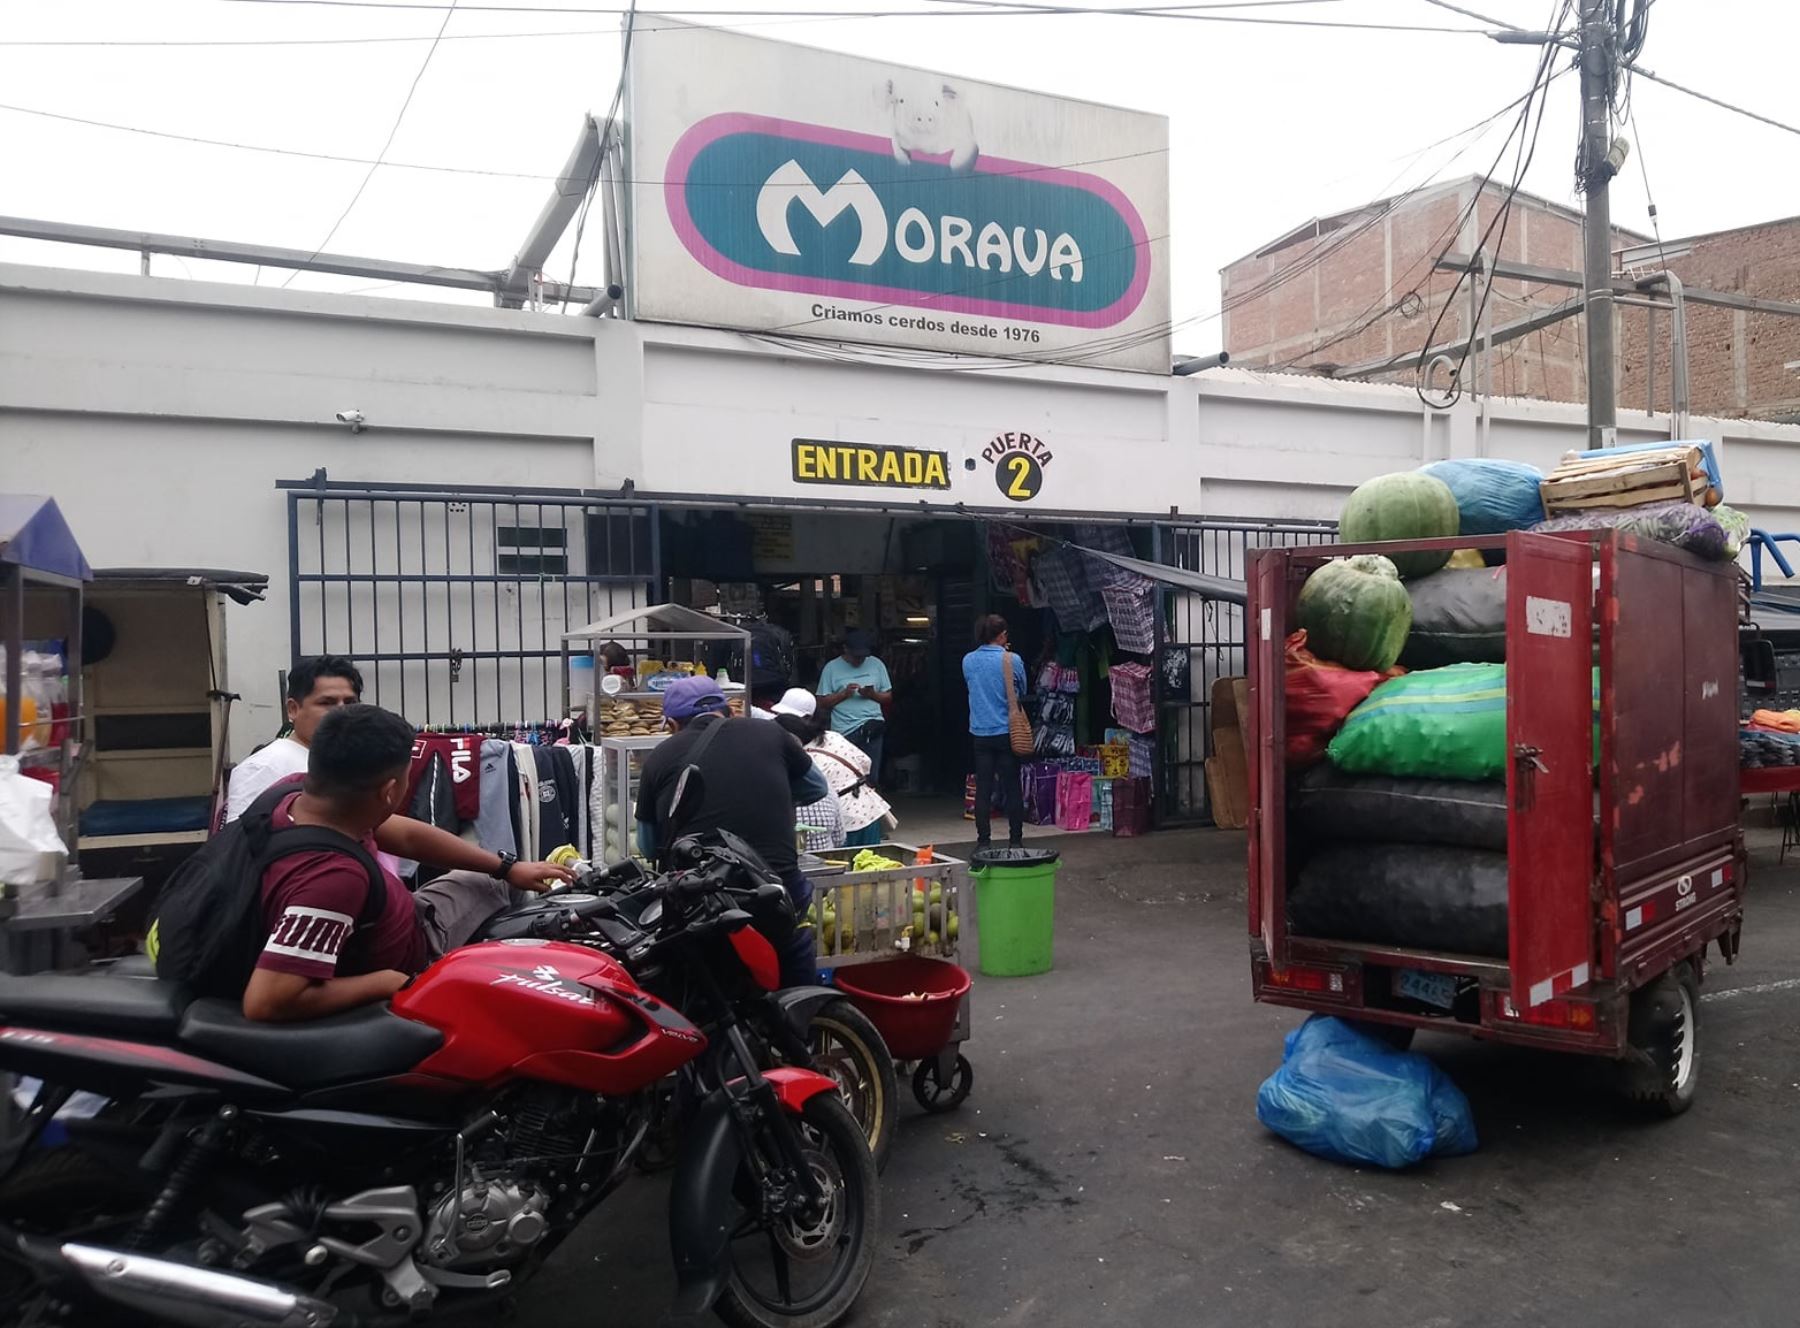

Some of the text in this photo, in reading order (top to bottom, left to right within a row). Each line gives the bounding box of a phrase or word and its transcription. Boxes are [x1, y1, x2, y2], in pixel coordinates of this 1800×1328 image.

[756, 159, 1083, 283] MORAVA
[811, 304, 1040, 343] Criamos cerdos desde 1976
[797, 445, 947, 485] ENTRADA
[981, 432, 1053, 467] PUERTA
[1008, 457, 1031, 497] 2
[450, 737, 472, 783] FILA
[270, 911, 354, 956] UM
